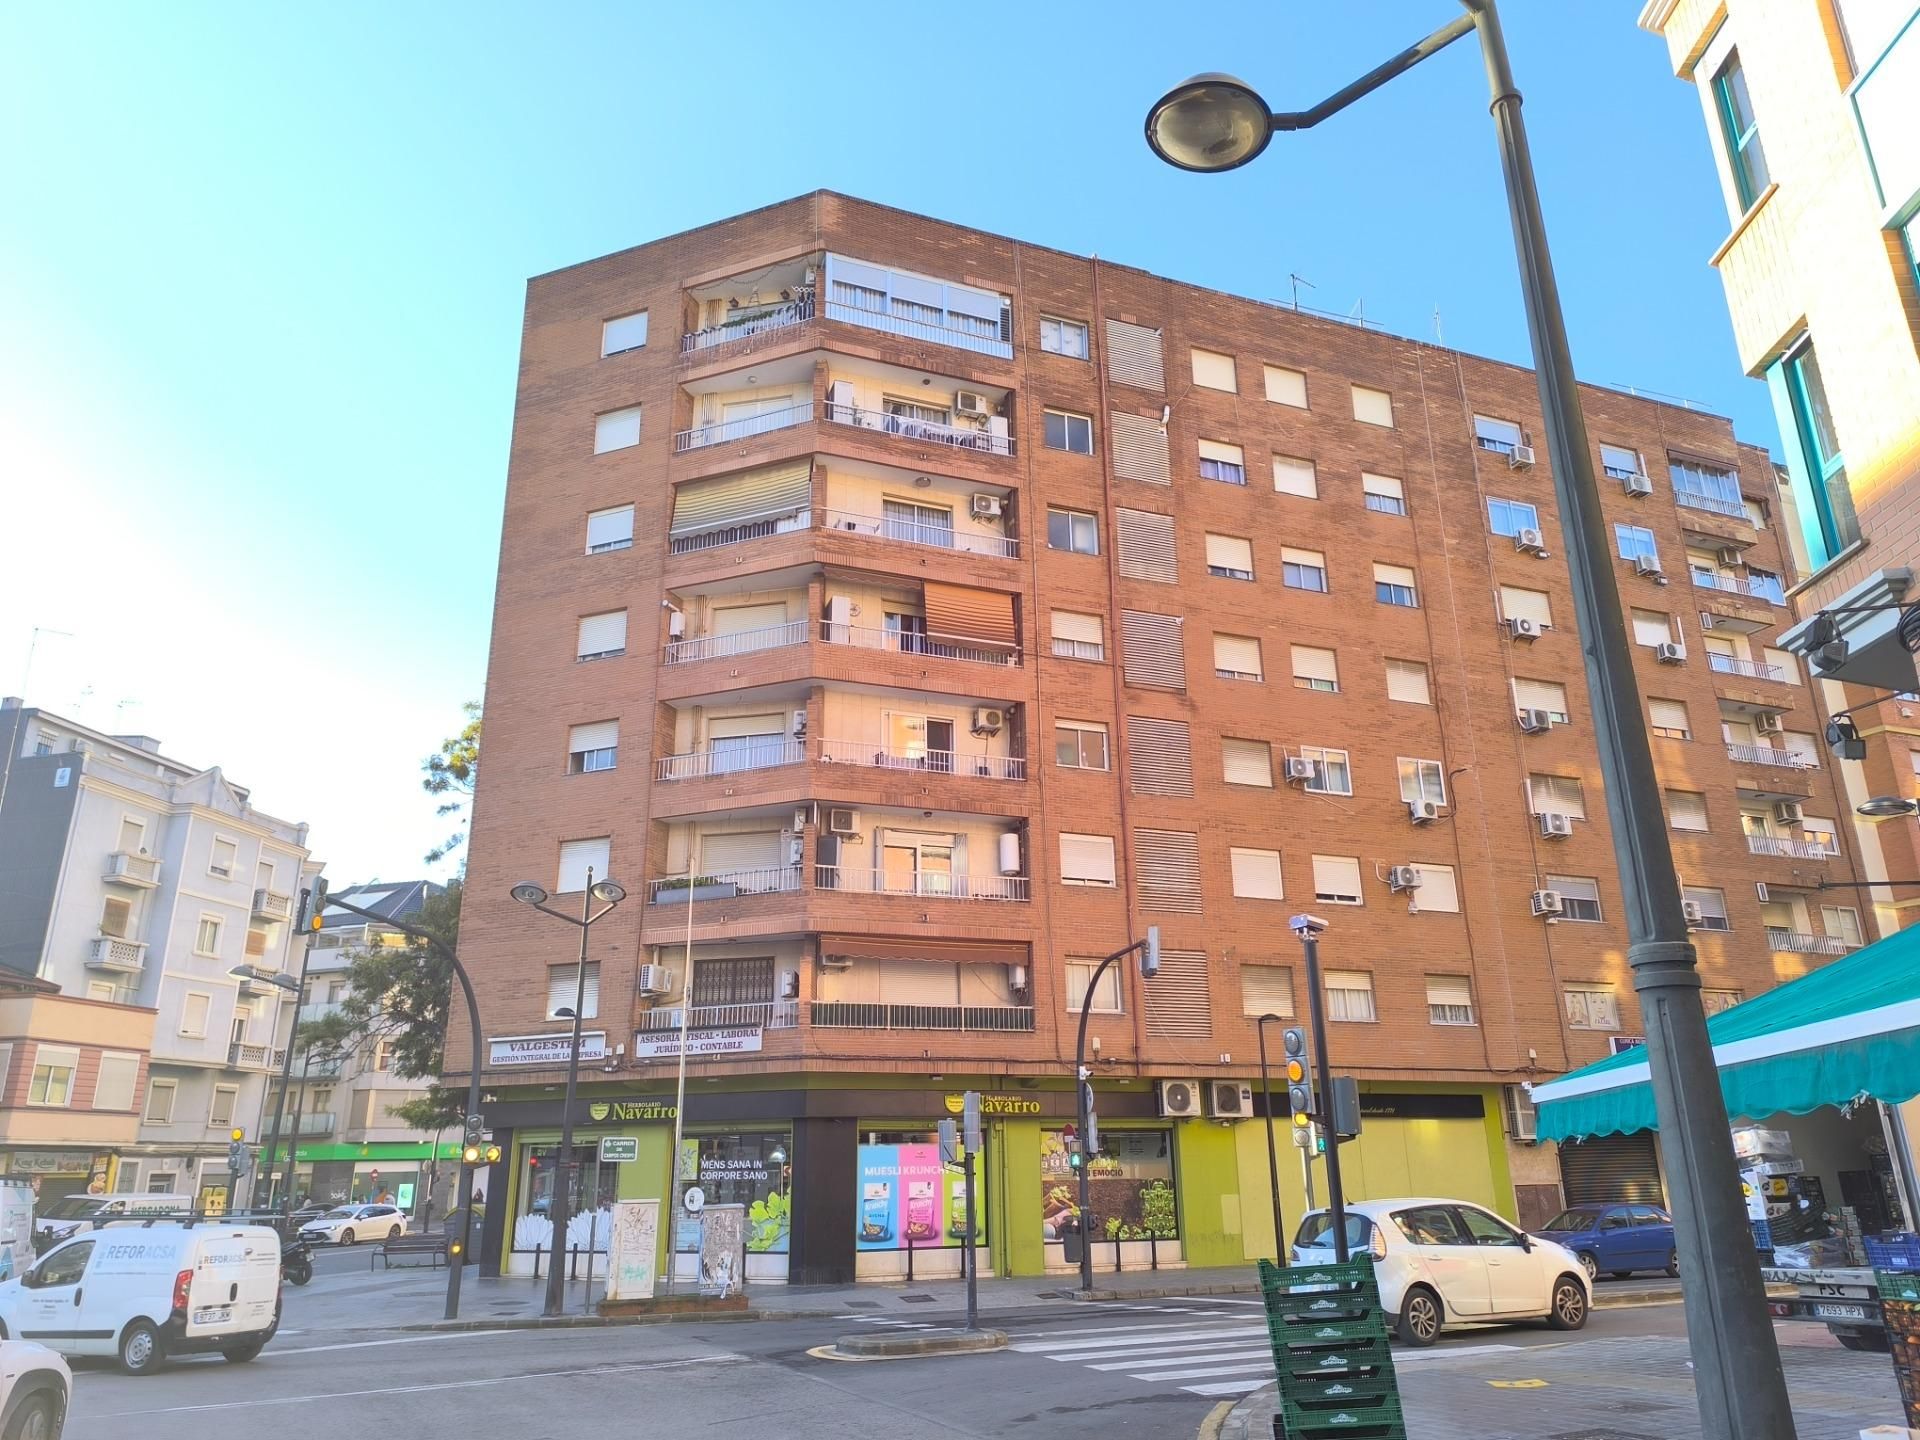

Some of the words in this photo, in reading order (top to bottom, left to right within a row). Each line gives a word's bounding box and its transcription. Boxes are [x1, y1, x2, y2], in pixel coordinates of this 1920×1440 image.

[639, 1032, 680, 1044] ASESORÍA
[686, 1031, 714, 1041] FISCAL
[721, 1029, 759, 1039] LABORAL
[700, 1041, 743, 1051] CONTABLE
[492, 1054, 519, 1063] GESTIÓN
[520, 1053, 551, 1062] INTEGRAL
[611, 1103, 678, 1120] Navarro
[701, 1160, 726, 1169] MENS
[727, 1160, 751, 1169] SANA
[753, 1160, 762, 1169] IN
[700, 1170, 741, 1180] CORPORE
[743, 1170, 768, 1180] SANO
[864, 1165, 901, 1177] MUESLI
[1092, 1167, 1124, 1177] EMOCIÓ
[106, 1245, 177, 1259] REFORACSA
[1821, 1304, 1842, 1316] 7693
[1845, 1306, 1863, 1317] HPX
